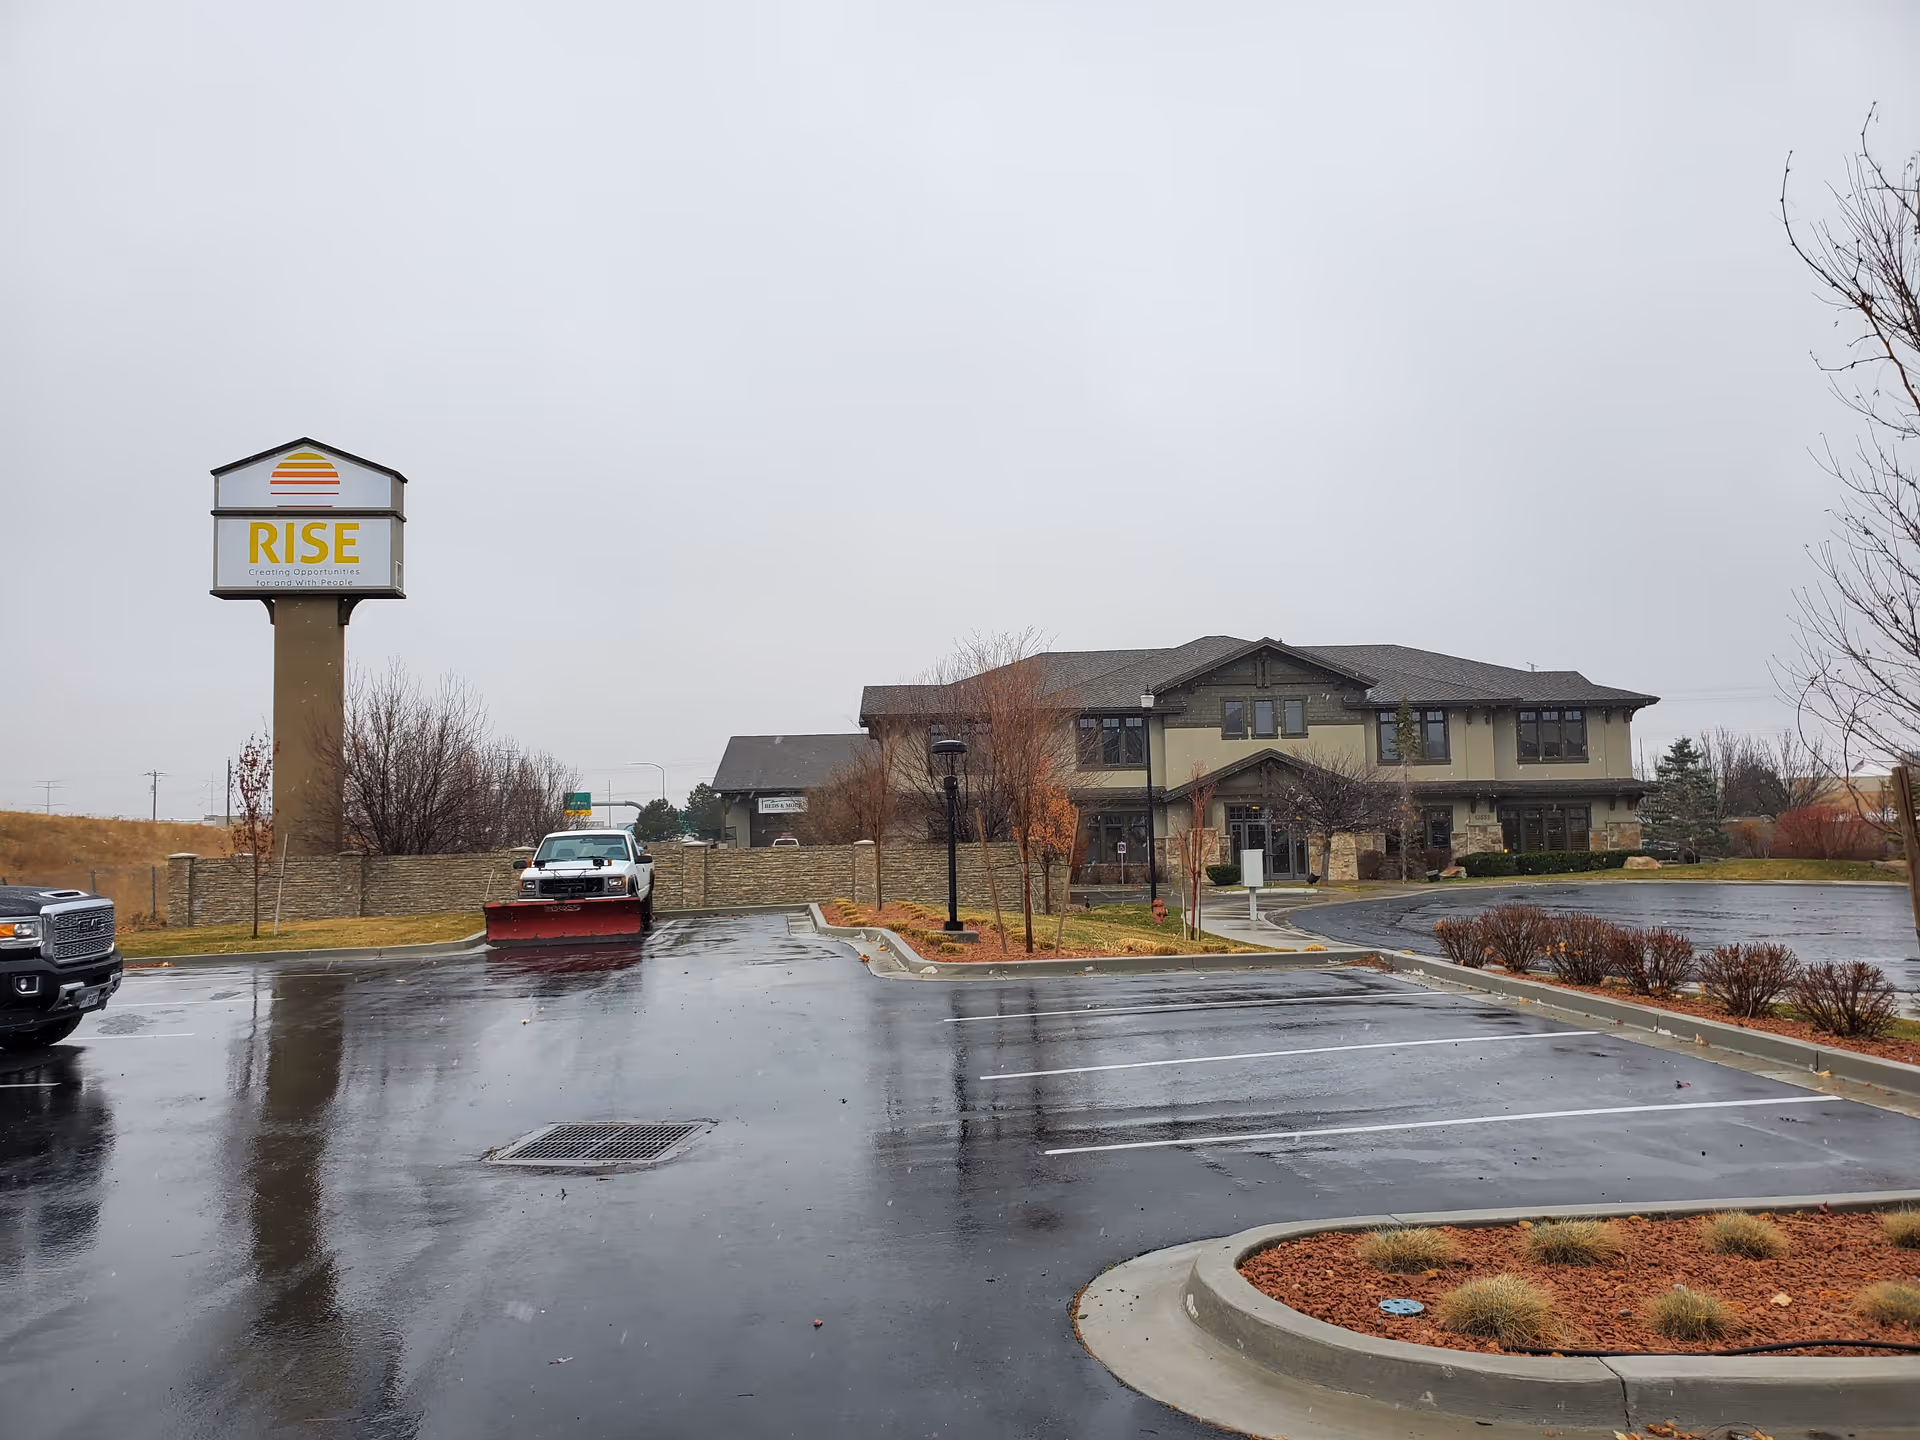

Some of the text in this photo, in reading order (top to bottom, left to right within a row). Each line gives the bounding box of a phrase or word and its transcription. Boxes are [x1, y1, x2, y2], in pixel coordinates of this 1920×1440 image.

[248, 522, 360, 564] RISE
[248, 568, 361, 577] Creating Opportunities
[256, 579, 270, 587] for
[274, 579, 292, 587] and
[320, 578, 353, 587] People
[79, 918, 106, 932] GMC
